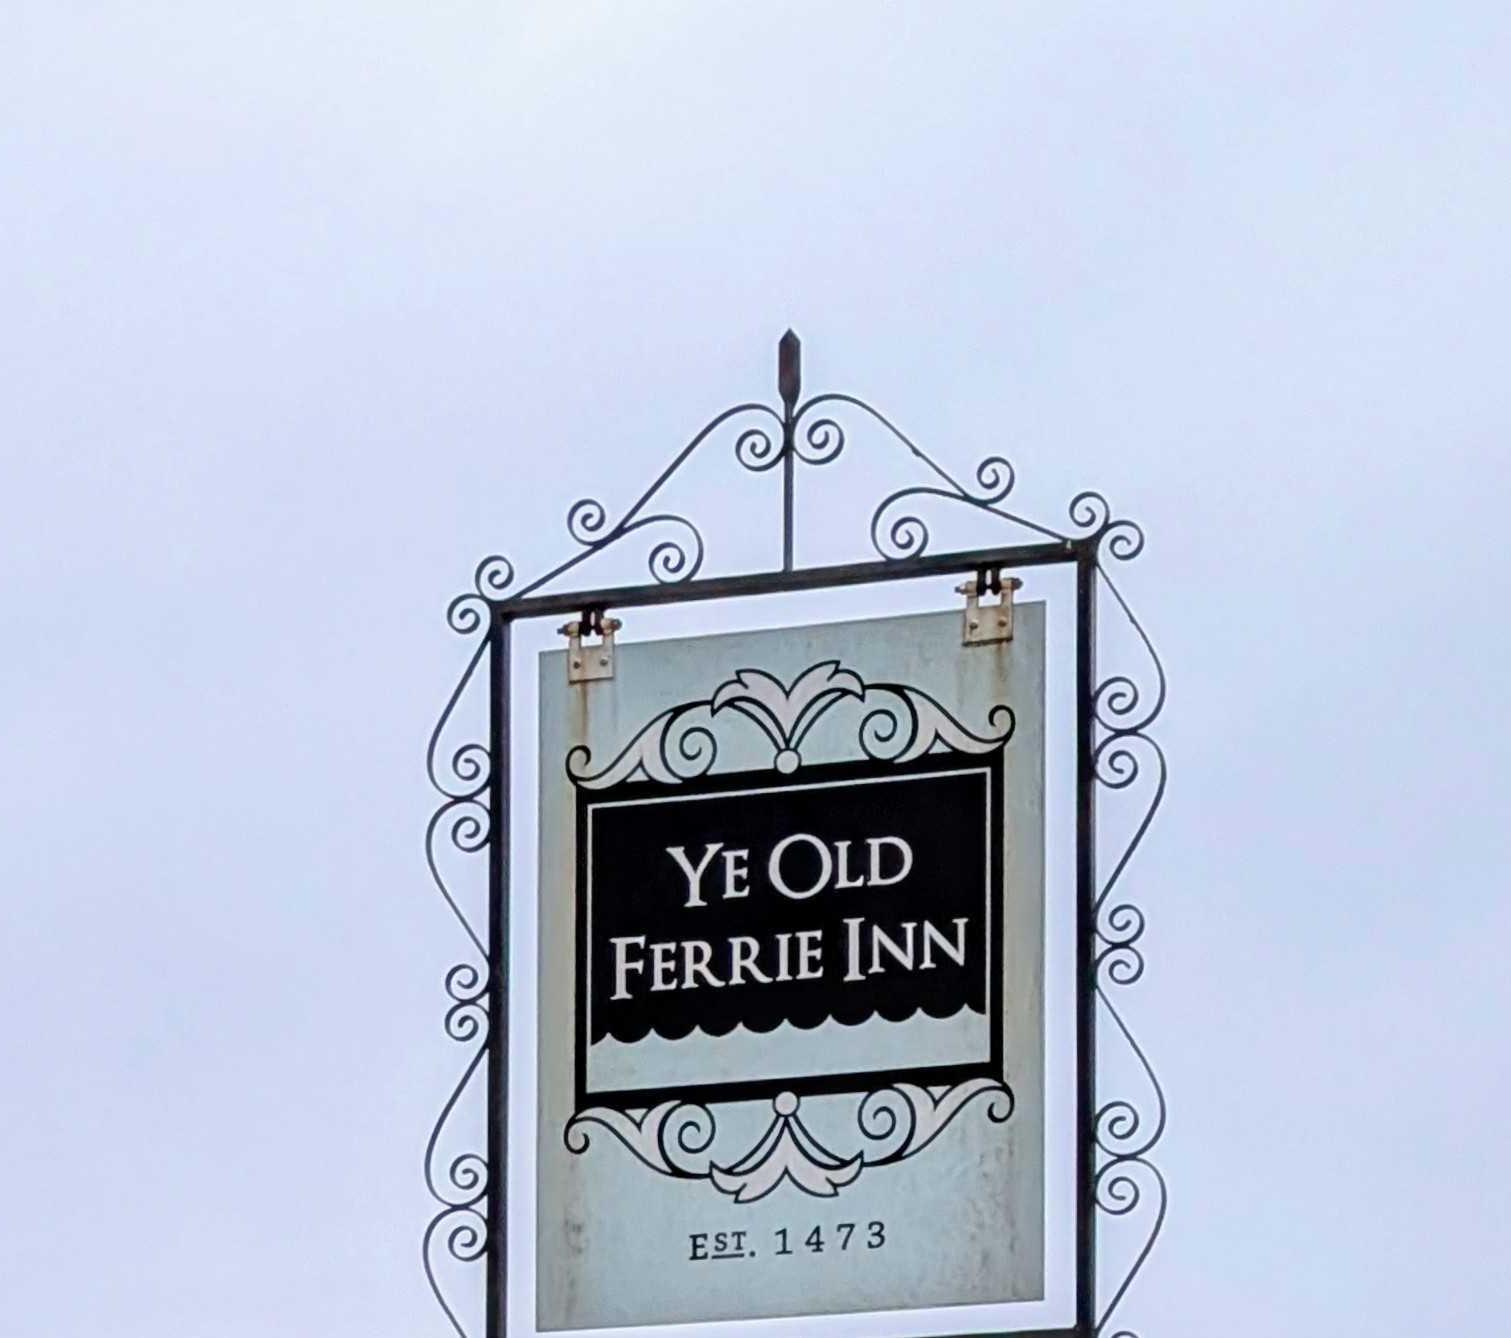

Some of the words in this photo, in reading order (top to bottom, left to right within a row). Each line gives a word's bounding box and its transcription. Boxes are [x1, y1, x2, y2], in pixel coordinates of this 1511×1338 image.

[768, 833, 913, 900] OLD
[609, 930, 825, 1001] FERRIE
[843, 917, 969, 983] INN
[774, 1220, 886, 1256] 1473
